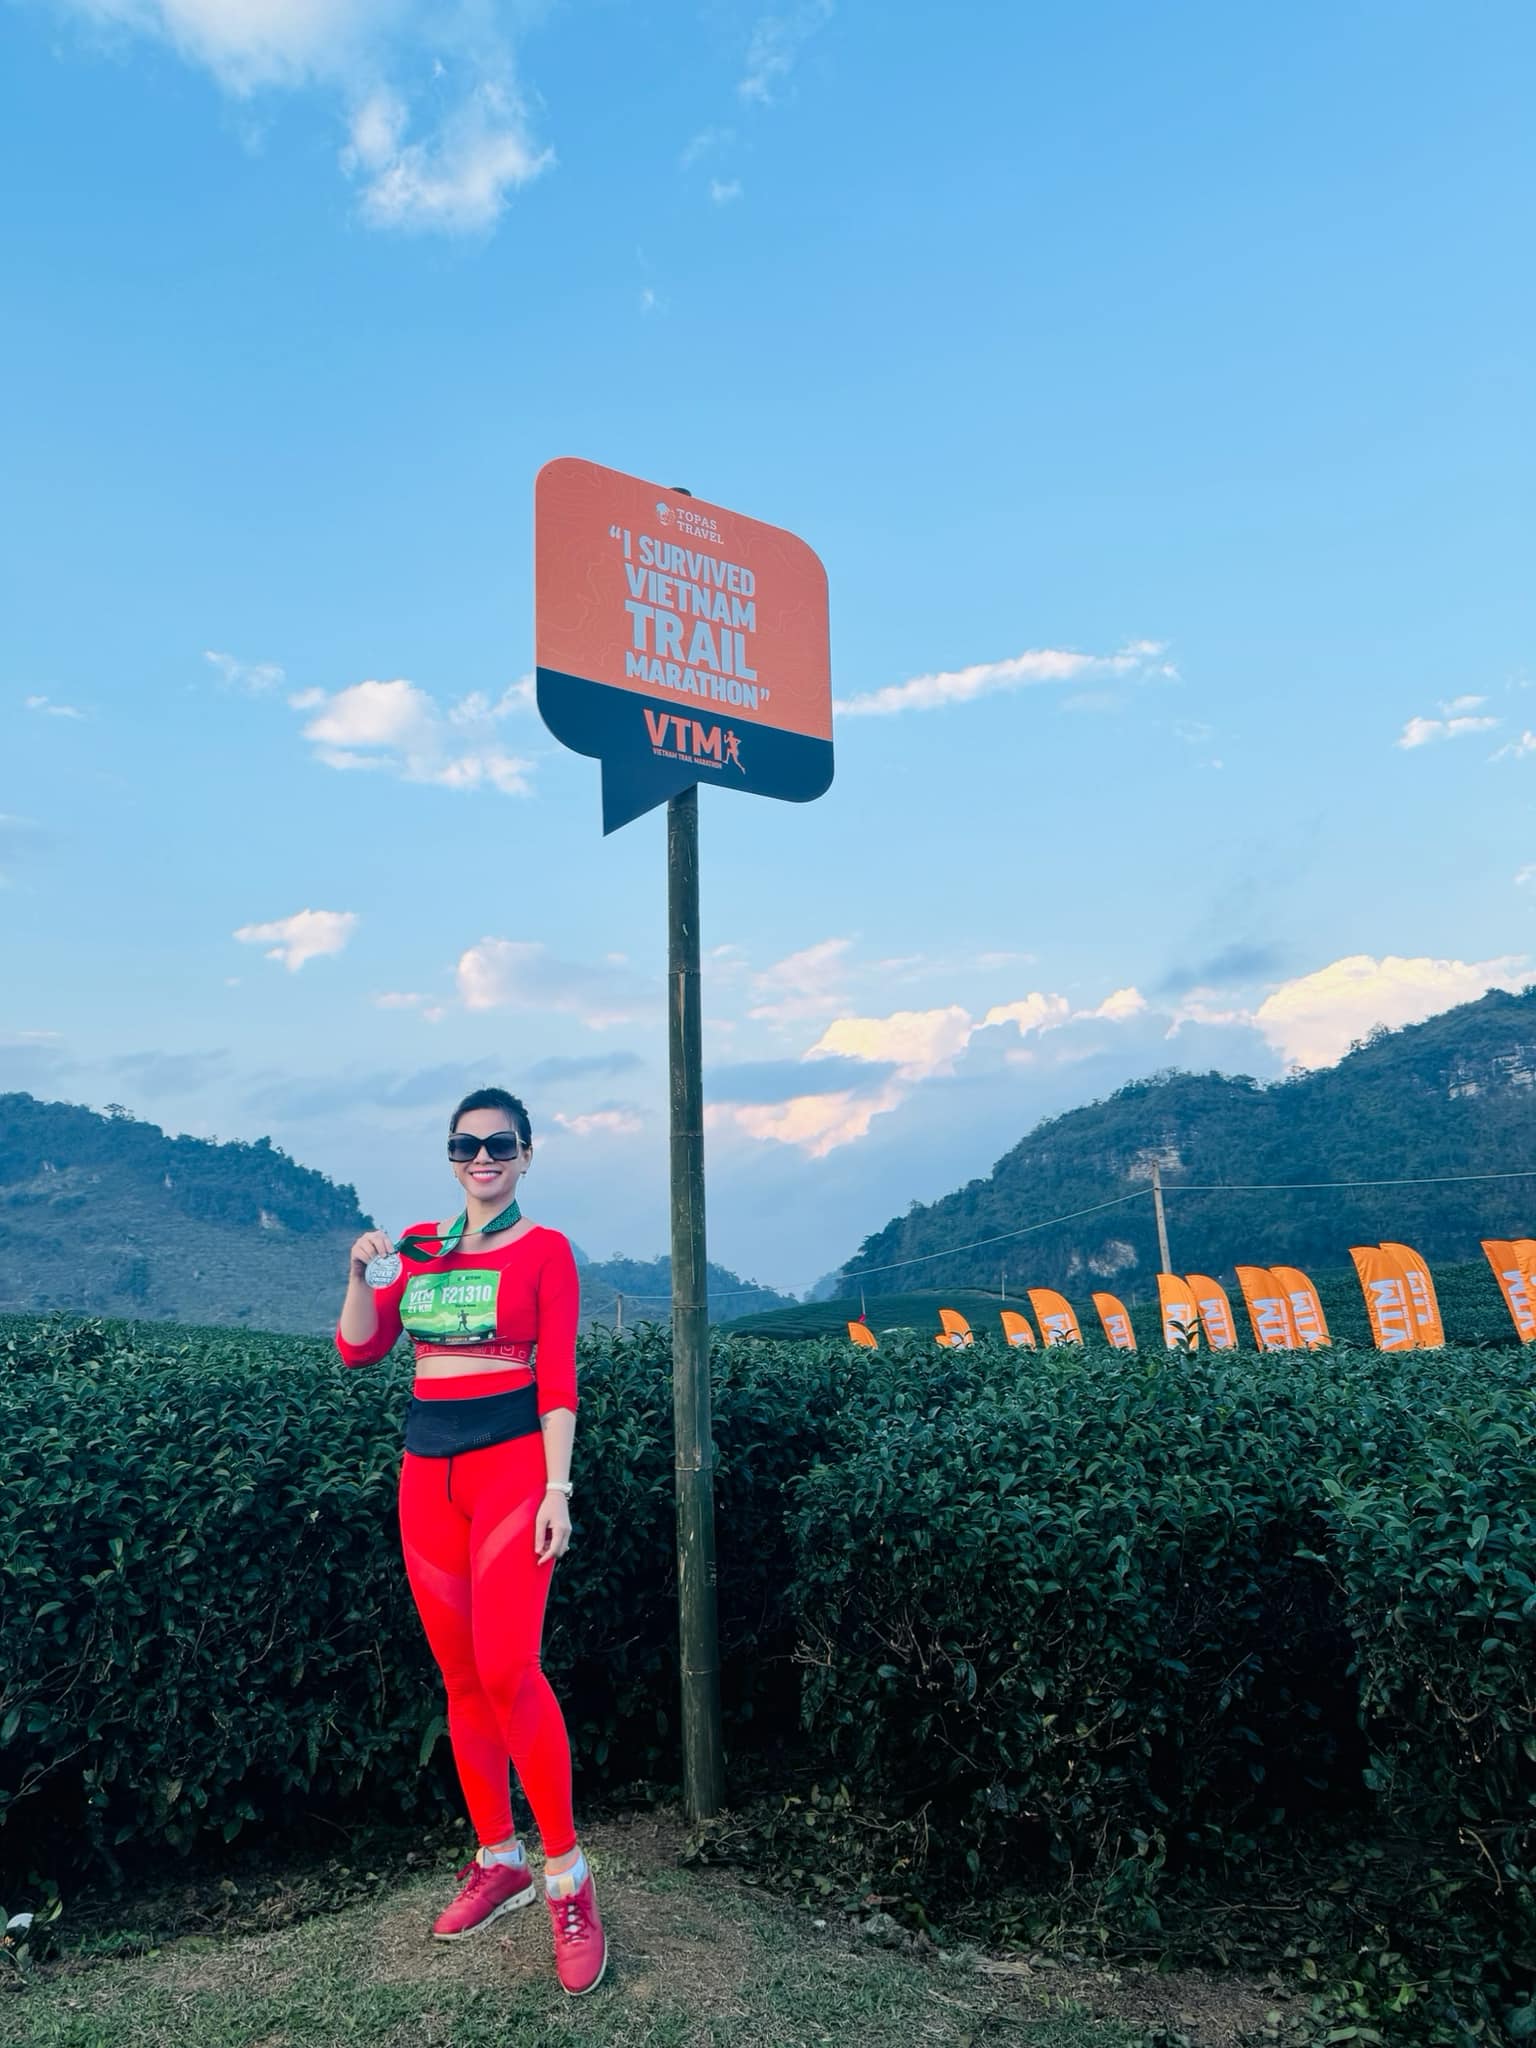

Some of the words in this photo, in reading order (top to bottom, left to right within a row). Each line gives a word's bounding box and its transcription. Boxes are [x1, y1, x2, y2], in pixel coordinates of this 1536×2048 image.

[676, 508, 717, 530] TOPAS
[677, 520, 724, 545] TRAVEL
[639, 534, 756, 597] SURVIVED
[624, 562, 757, 633] VIETNAM
[624, 600, 758, 681] TRAIL
[643, 708, 722, 761] VTM
[653, 746, 678, 760] VIETNAM
[678, 753, 693, 763] TRAIL
[409, 1289, 436, 1303] VTM
[441, 1284, 493, 1304] F21310
[1369, 1279, 1407, 1349] VTM
